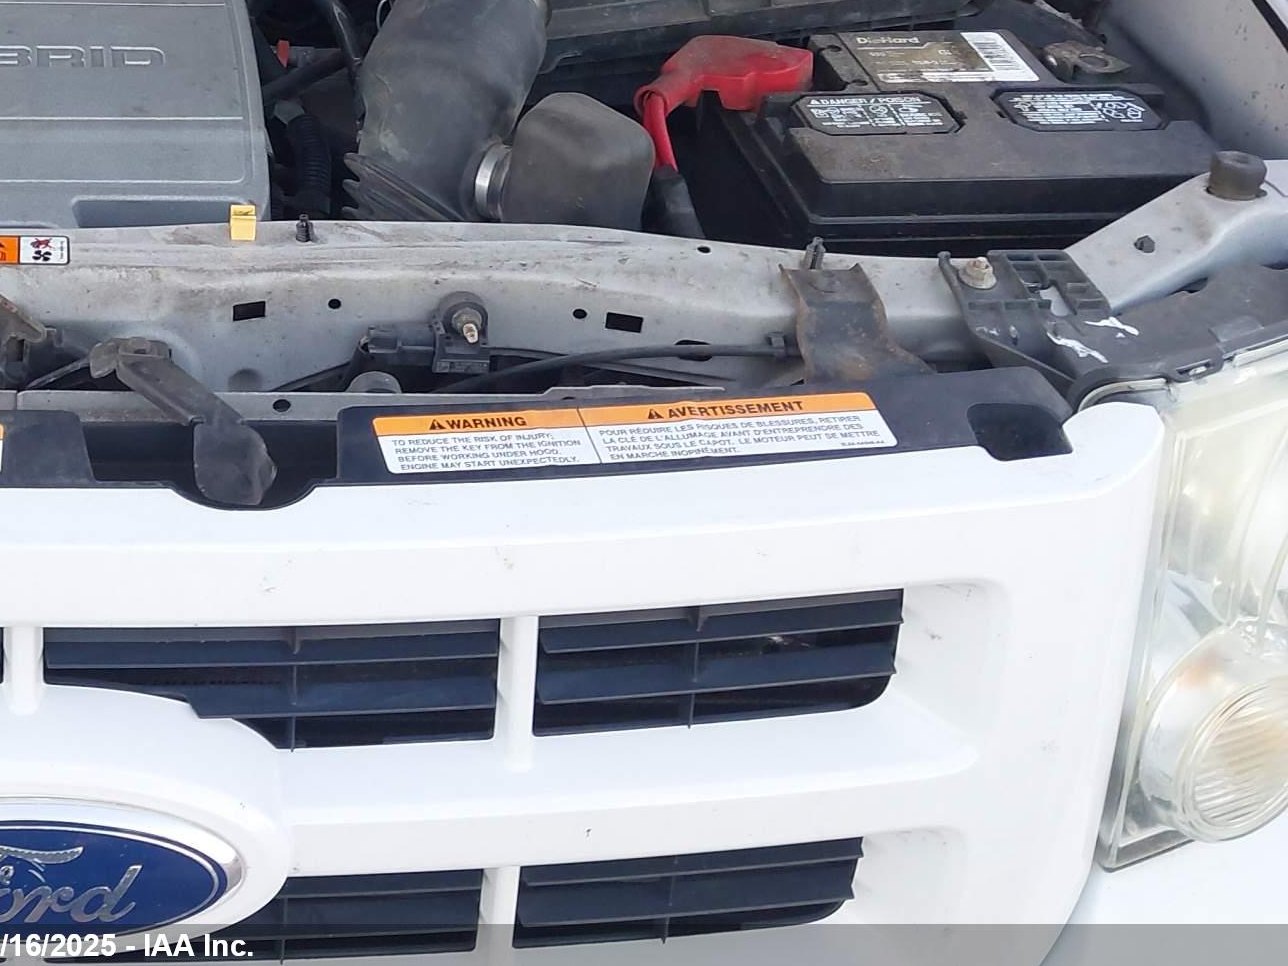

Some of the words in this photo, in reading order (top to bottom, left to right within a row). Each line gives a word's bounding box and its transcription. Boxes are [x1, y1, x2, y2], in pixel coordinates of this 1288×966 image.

[668, 400, 804, 419] AVERTISSEMENT
[446, 416, 528, 430] WARNING
[392, 438, 406, 446] TO
[408, 436, 449, 446] REDUCE
[453, 436, 472, 444] THE
[500, 434, 513, 442] OF
[394, 446, 438, 454] REMOVE
[462, 444, 482, 452] KEY
[484, 443, 513, 451] FROM
[538, 440, 582, 448] IGNITION
[398, 454, 439, 462] BEFORE
[442, 452, 490, 461] WORKING
[492, 450, 528, 458] UNDER
[400, 462, 438, 470] ENGINE
[464, 460, 498, 468] START
